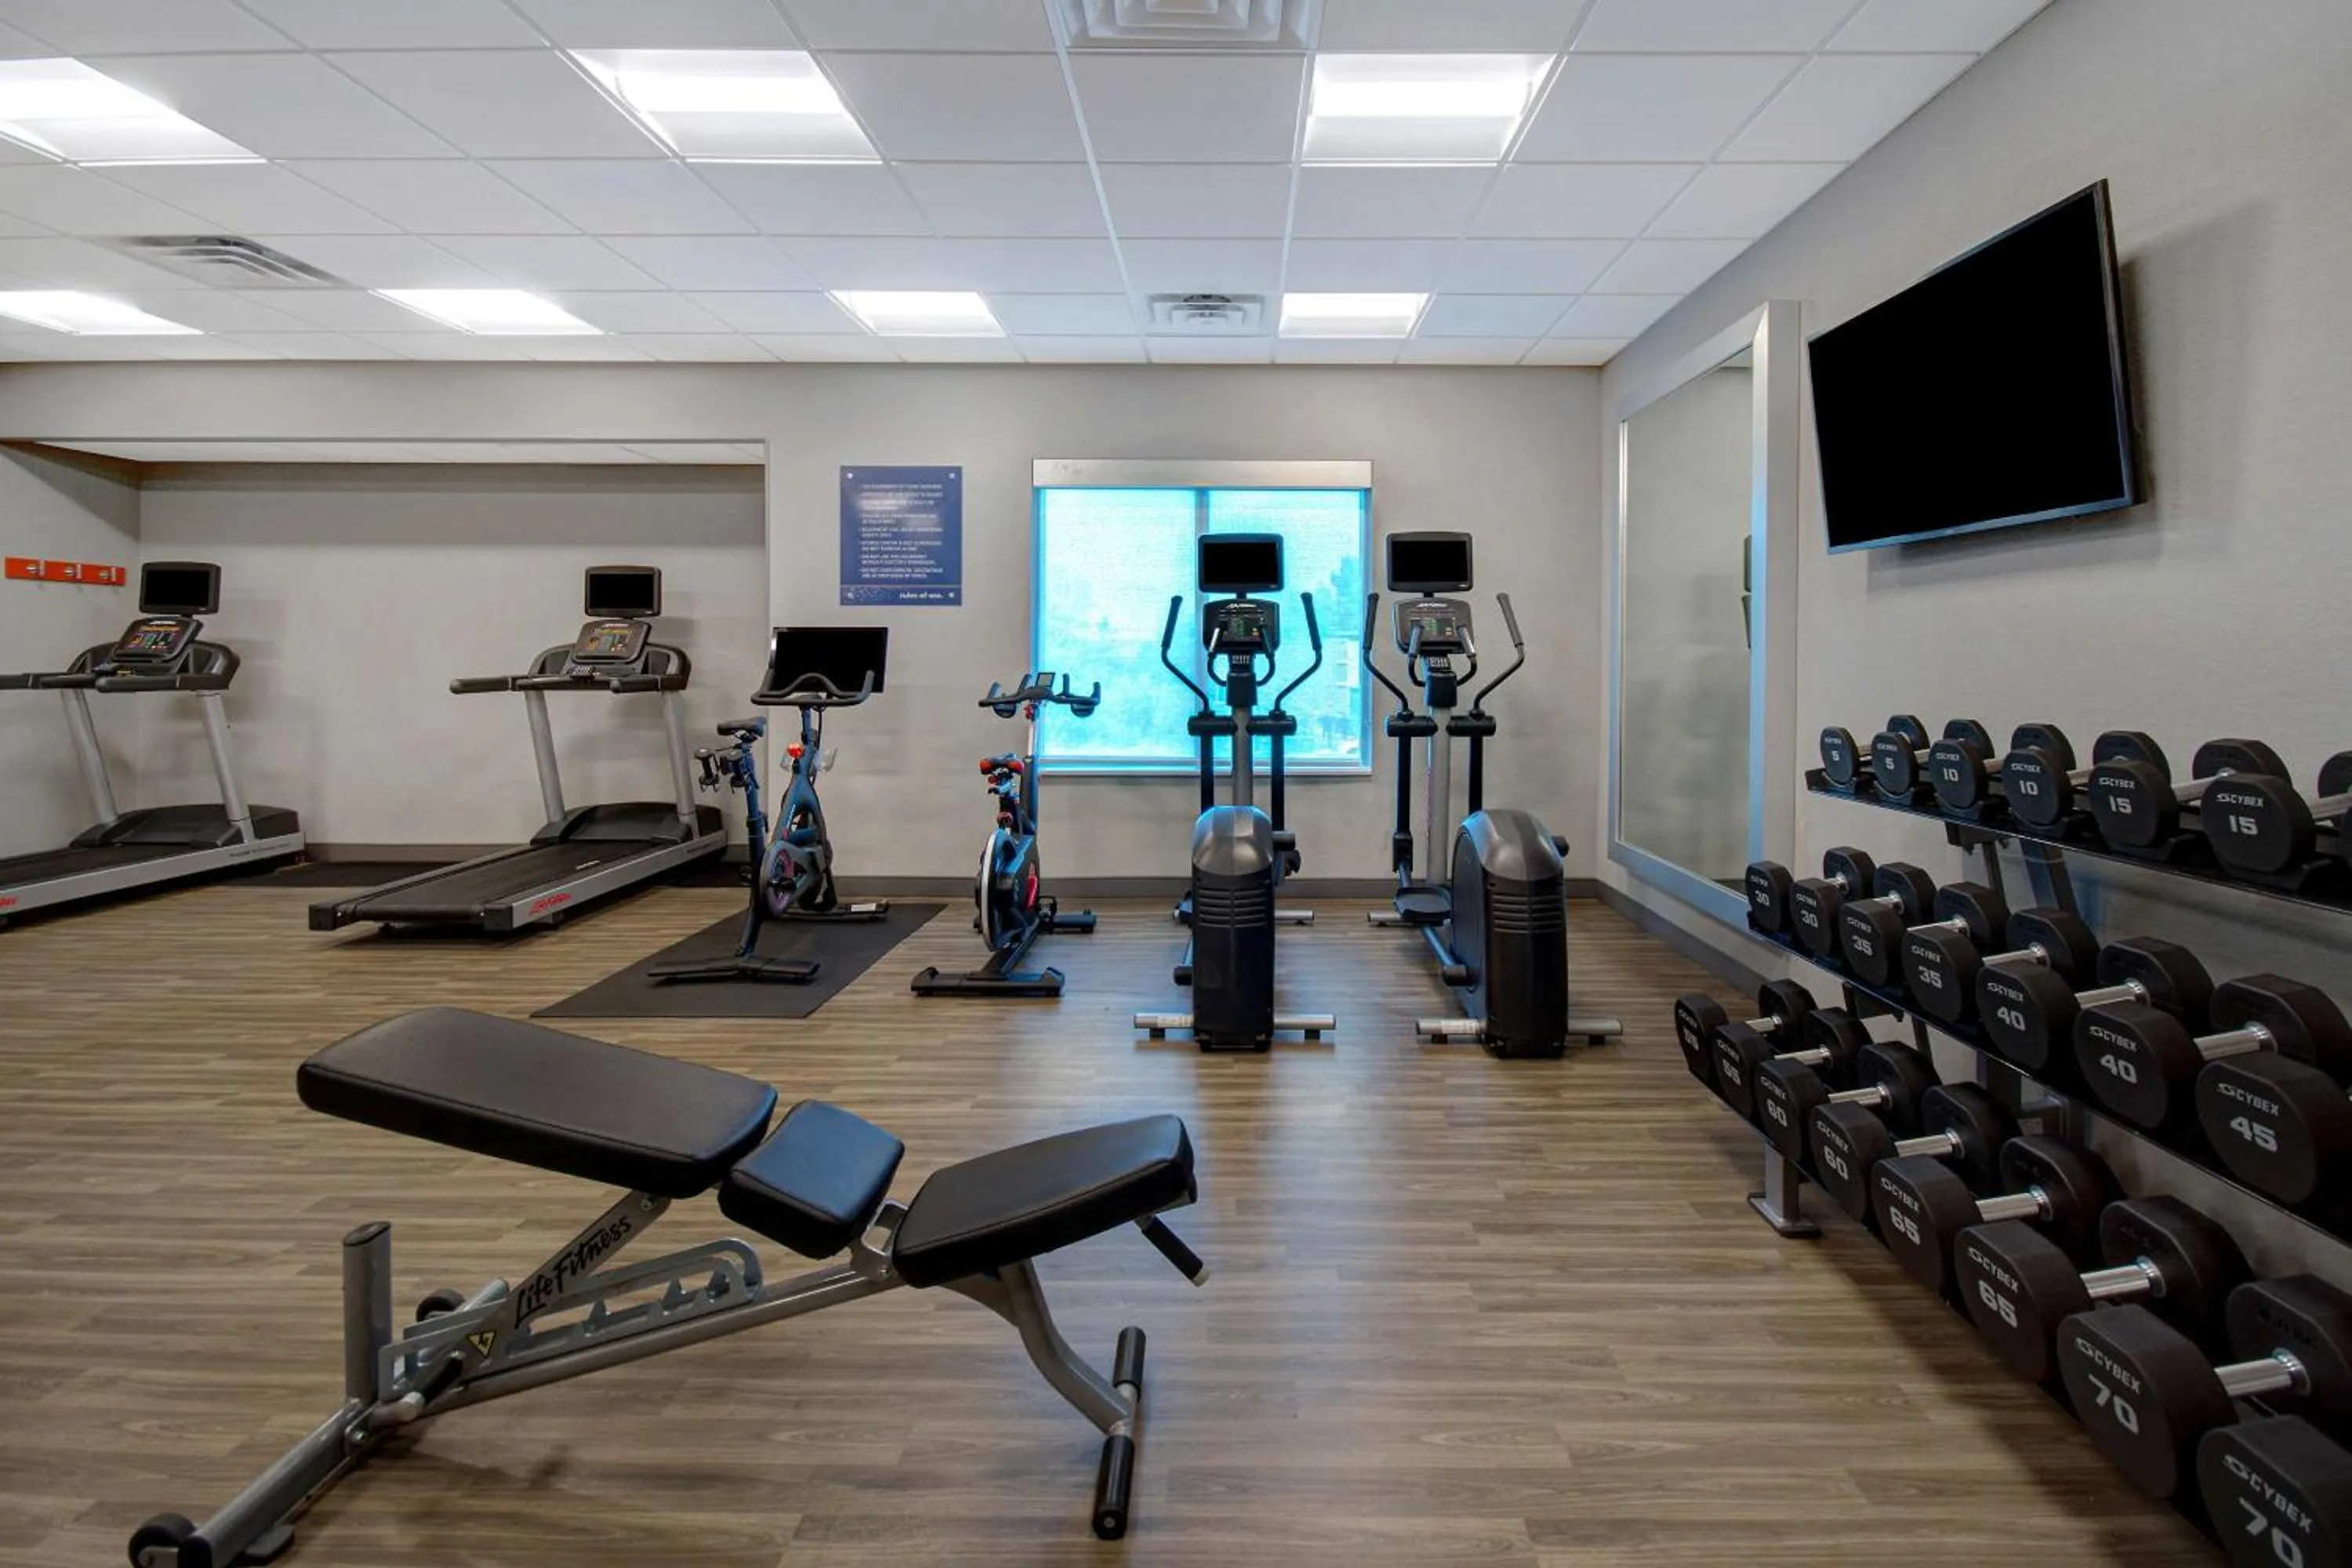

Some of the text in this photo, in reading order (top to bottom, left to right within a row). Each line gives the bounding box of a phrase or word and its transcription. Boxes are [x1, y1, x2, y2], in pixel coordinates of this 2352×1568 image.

[1831, 750, 1840, 761] 5
[1885, 757, 1895, 770] 5
[1944, 768, 1958, 782] 10
[2019, 779, 2038, 796] 10
[2108, 795, 2132, 815] 15
[2229, 815, 2259, 836] 15
[1755, 890, 1770, 907] 30
[1801, 910, 1819, 928] 30
[1852, 935, 1873, 956] 35
[1918, 965, 1943, 989] 35
[1996, 1006, 2026, 1032] 40
[2100, 1054, 2139, 1084] 40
[1766, 1098, 1788, 1127] 60
[2230, 1115, 2278, 1153] 45
[1824, 1145, 1849, 1180] 60
[1889, 1205, 1920, 1246] 65
[1978, 1279, 2018, 1329] 65
[2088, 1373, 2140, 1436] 70
[2249, 1472, 2314, 1534] CYBEX
[2238, 1496, 2304, 1568] 70
